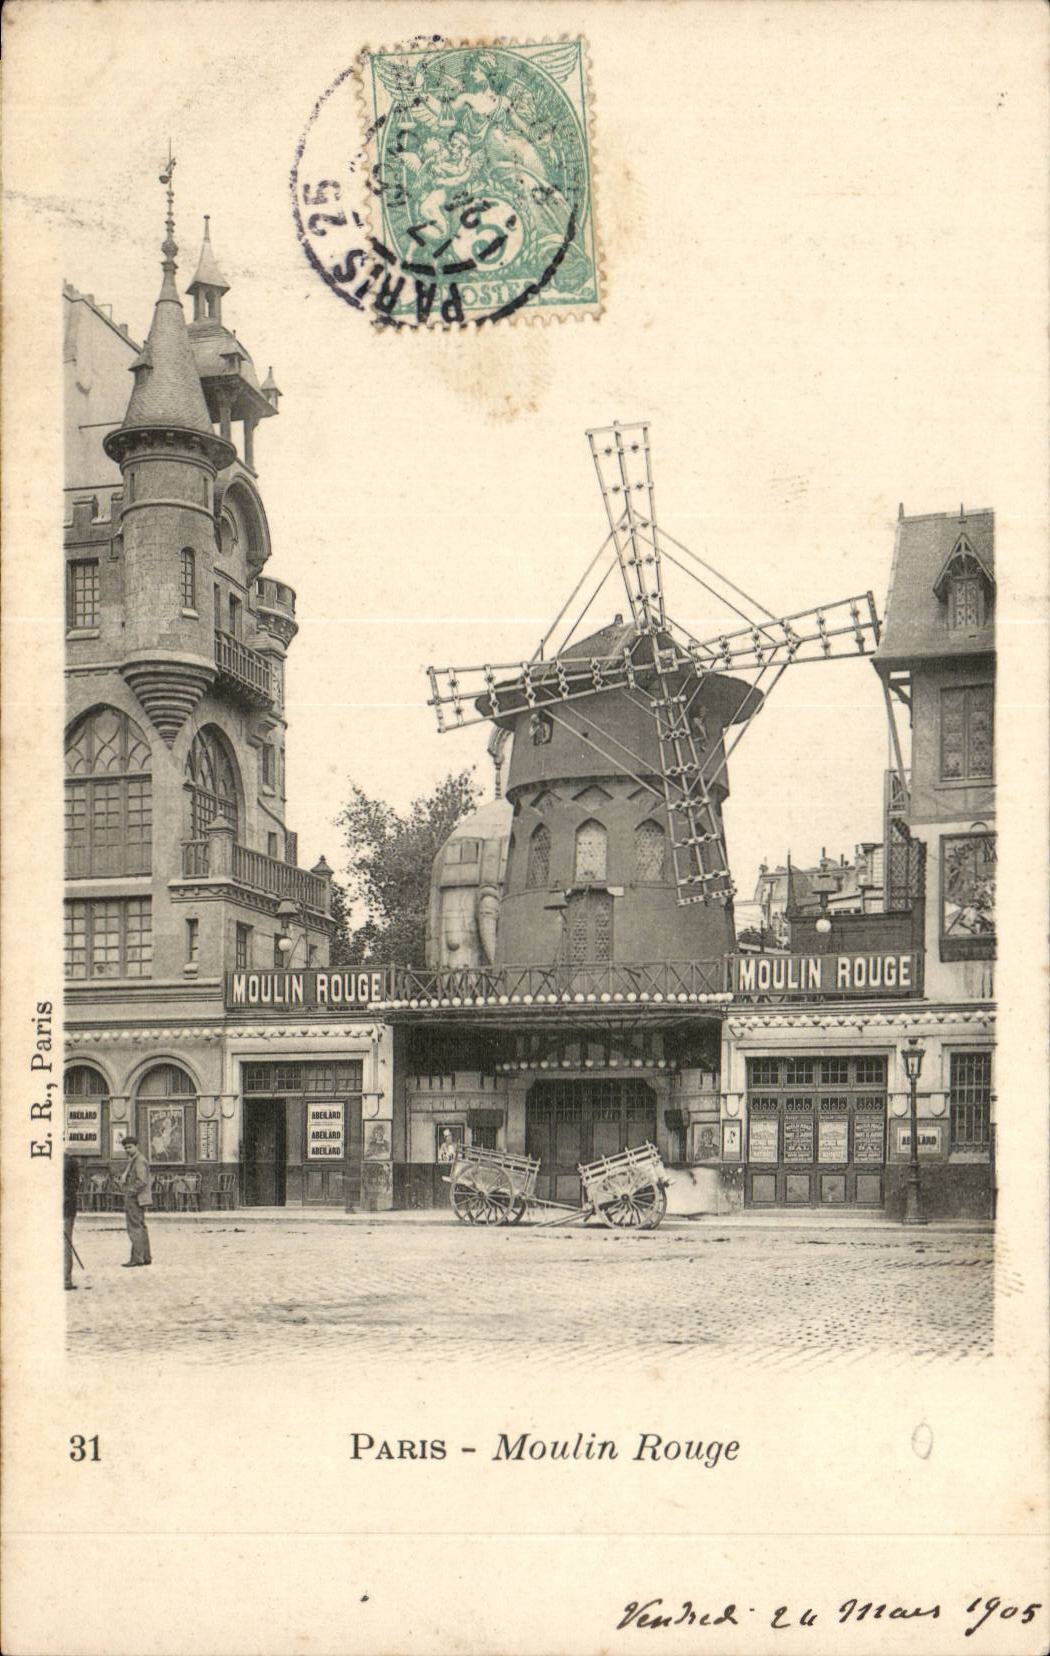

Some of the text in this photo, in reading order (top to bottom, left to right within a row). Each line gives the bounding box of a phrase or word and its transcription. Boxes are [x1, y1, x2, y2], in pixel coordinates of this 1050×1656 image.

[332, 248, 465, 324] PARIS
[232, 972, 382, 1003] MOULIN ROUGE
[739, 955, 912, 990] MOULIN ROUGE
[964, 1596, 1043, 1637] 1905
